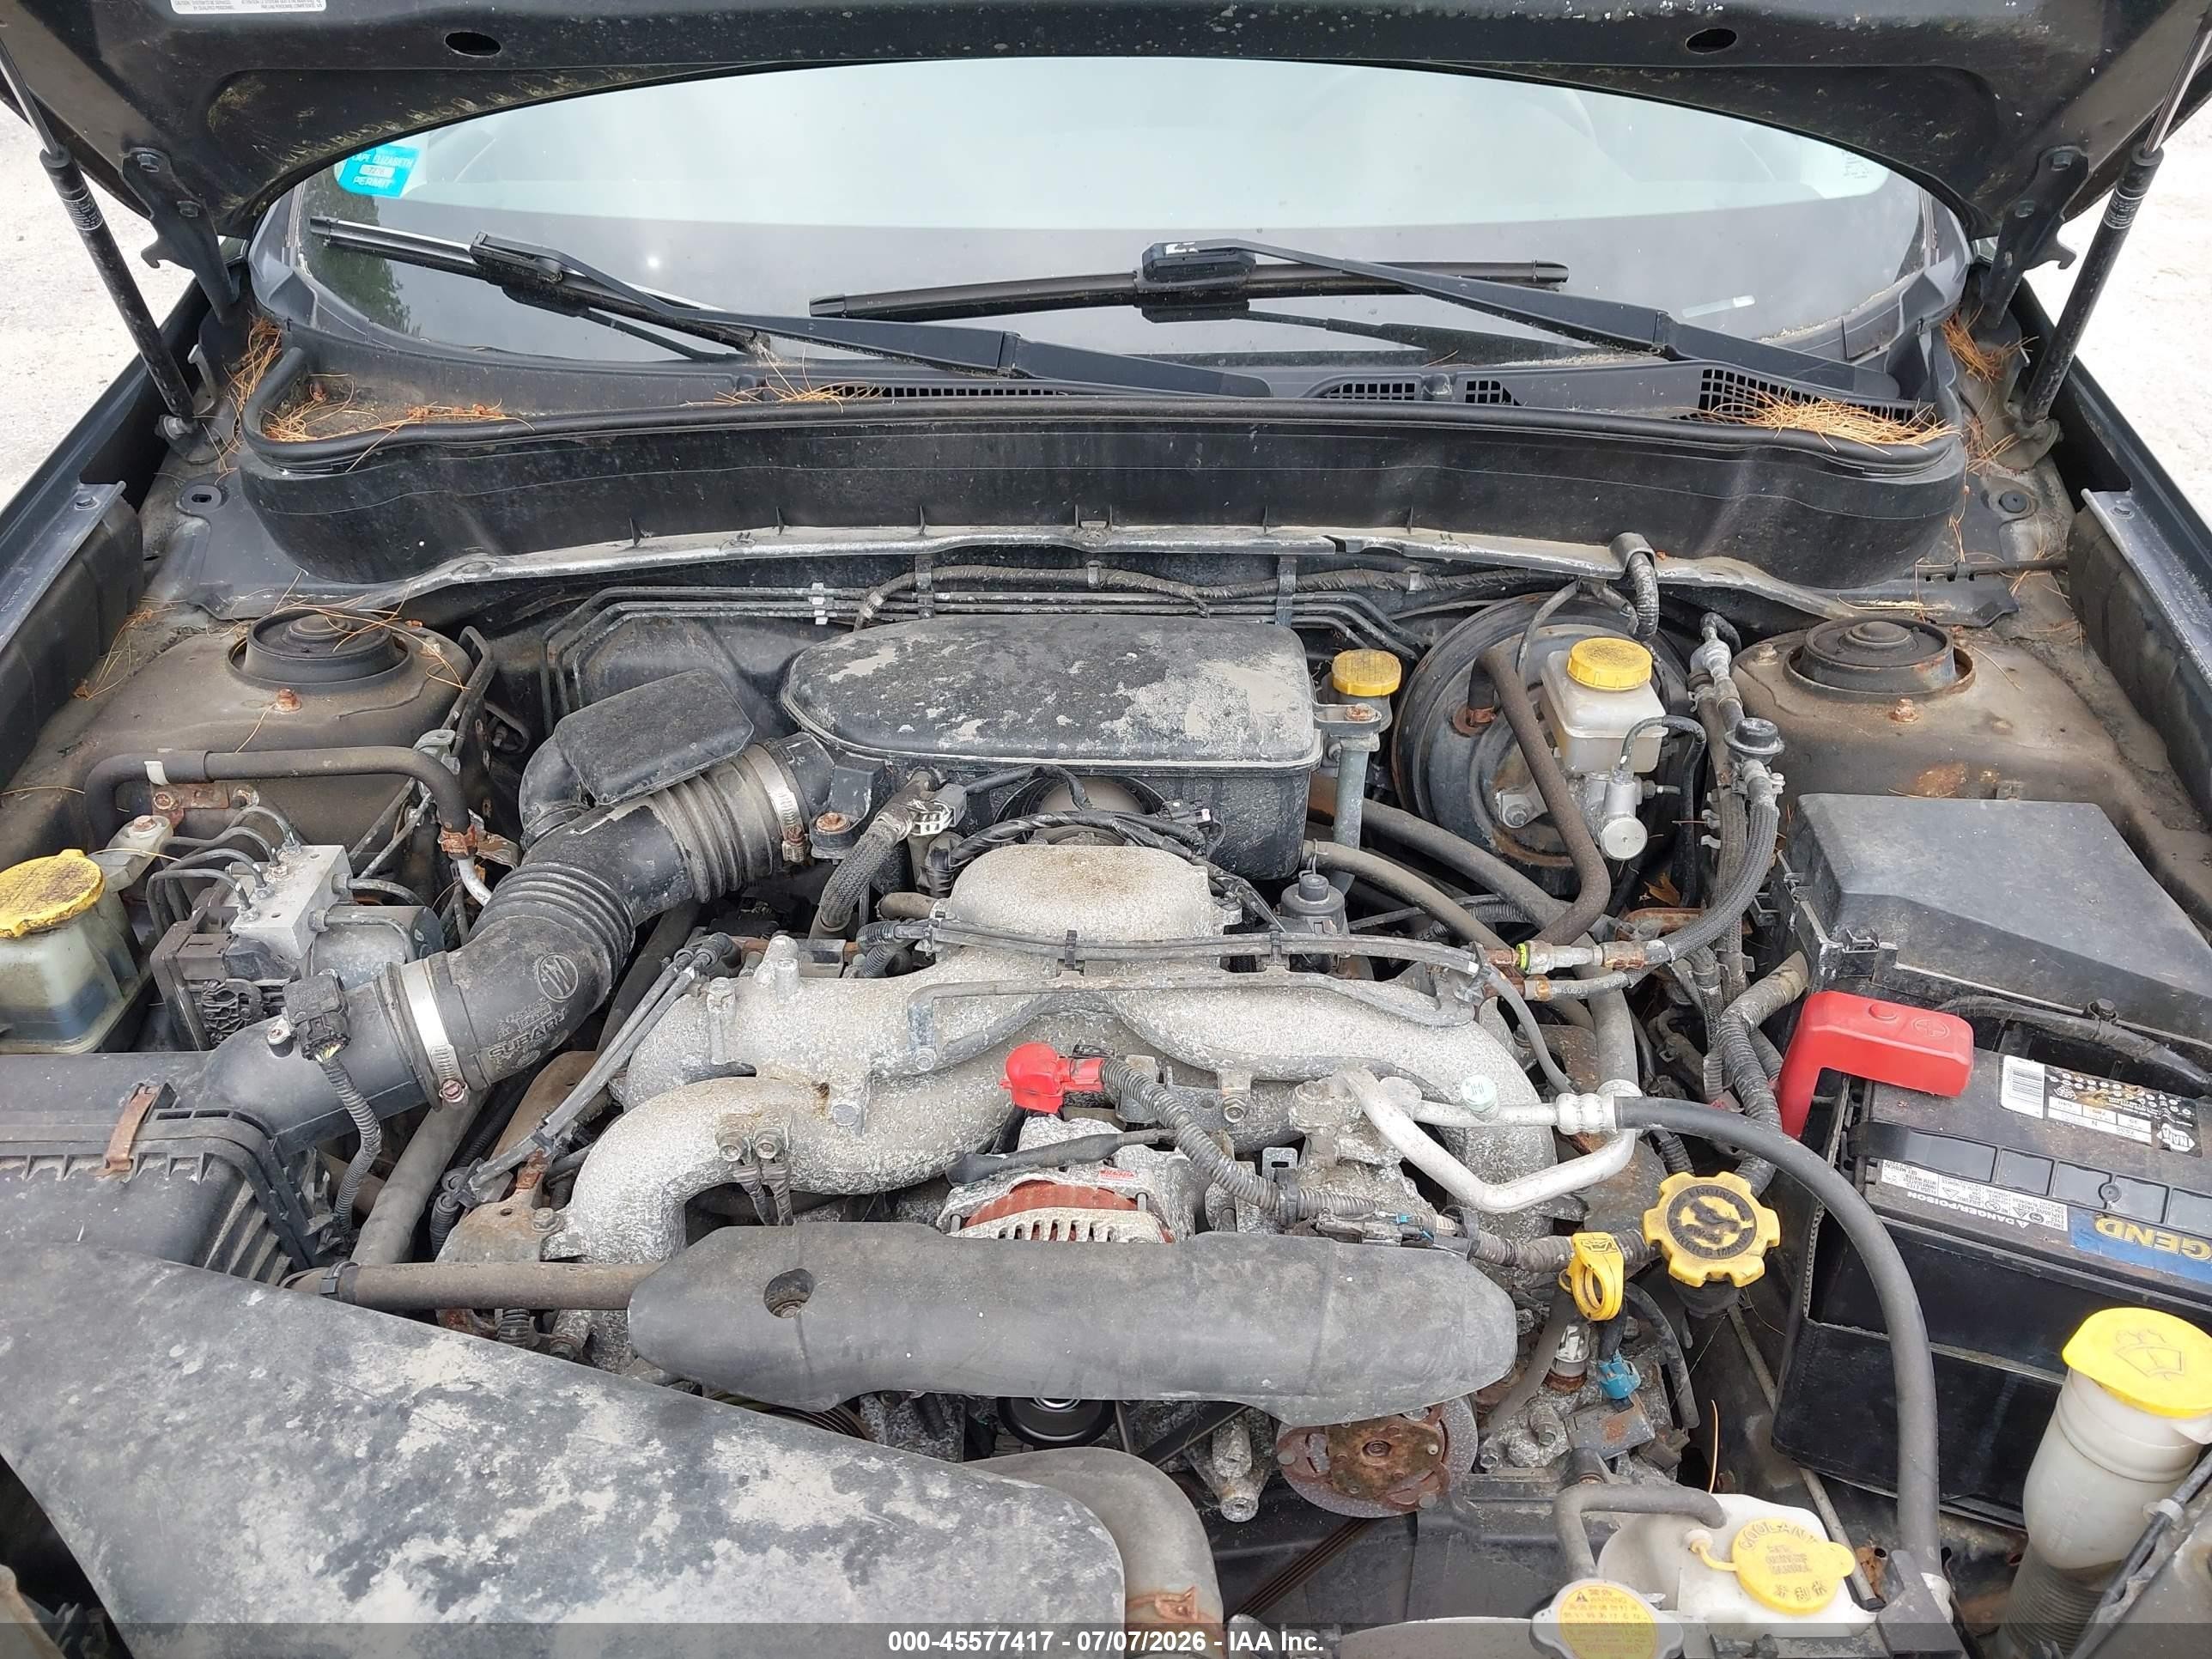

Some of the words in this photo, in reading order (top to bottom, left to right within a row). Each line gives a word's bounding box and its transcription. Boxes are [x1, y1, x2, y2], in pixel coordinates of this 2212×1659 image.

[372, 155, 413, 167] ELIZABETH
[352, 175, 392, 188] PERMIT
[1905, 1190, 2014, 1225] DANGER/POISON
[1738, 1521, 1818, 1550] COOLANT
